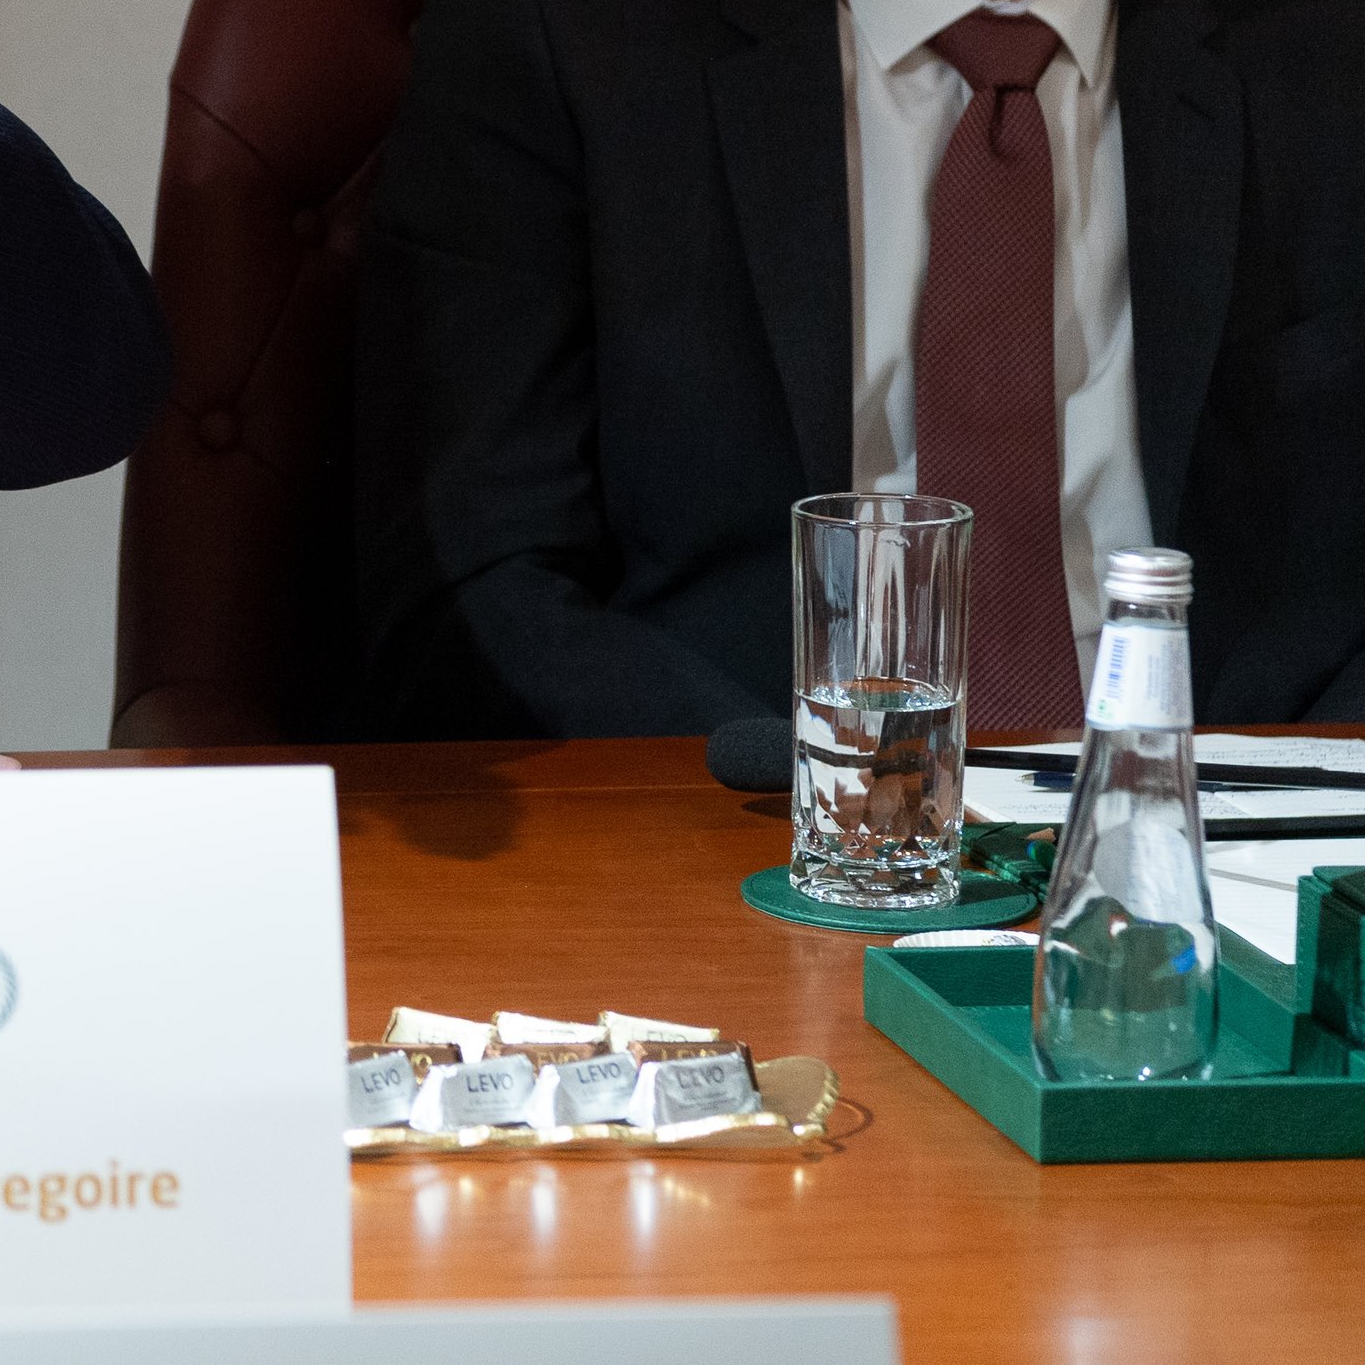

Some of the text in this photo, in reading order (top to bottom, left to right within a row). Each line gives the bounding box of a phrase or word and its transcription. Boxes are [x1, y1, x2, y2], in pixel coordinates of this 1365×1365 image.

[361, 1067, 402, 1093] LEVO
[465, 1072, 514, 1093] LEVO
[575, 1061, 622, 1084] LEVO
[677, 1065, 725, 1089] LEVO
